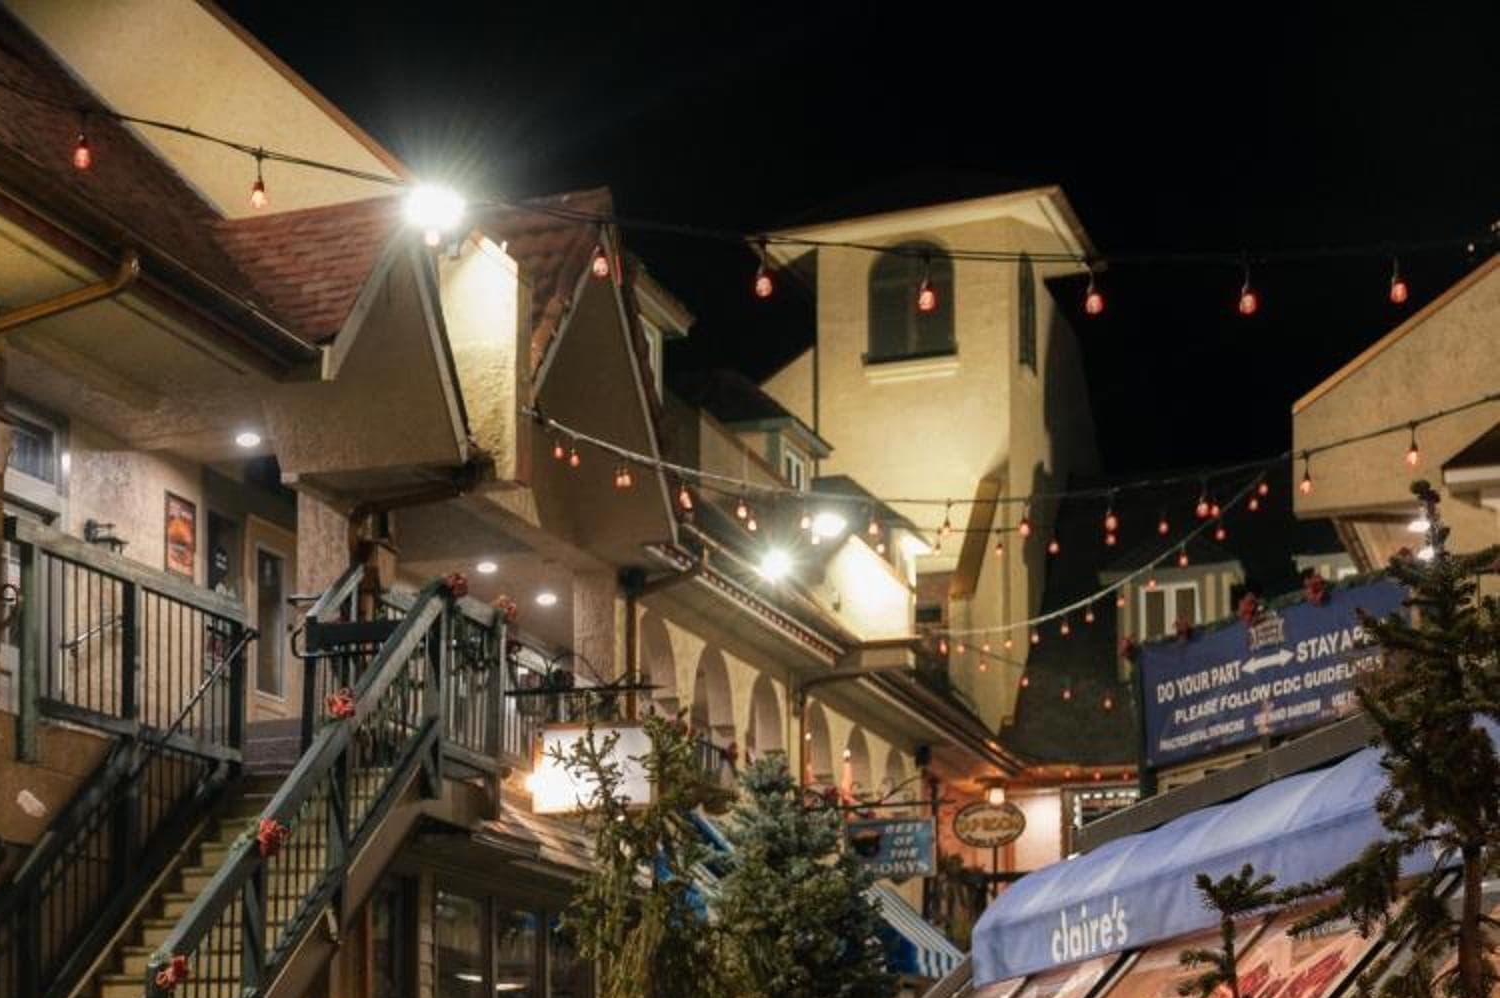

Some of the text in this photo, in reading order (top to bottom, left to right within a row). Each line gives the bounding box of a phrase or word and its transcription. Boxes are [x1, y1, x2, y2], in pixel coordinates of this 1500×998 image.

[1296, 630, 1340, 662] STAY
[1157, 660, 1244, 704] DO YOUR PART
[1174, 699, 1219, 725] PLEASE
[1220, 684, 1273, 712] FOLLOW
[1273, 675, 1302, 697] CDC
[1052, 896, 1127, 962] claire's
